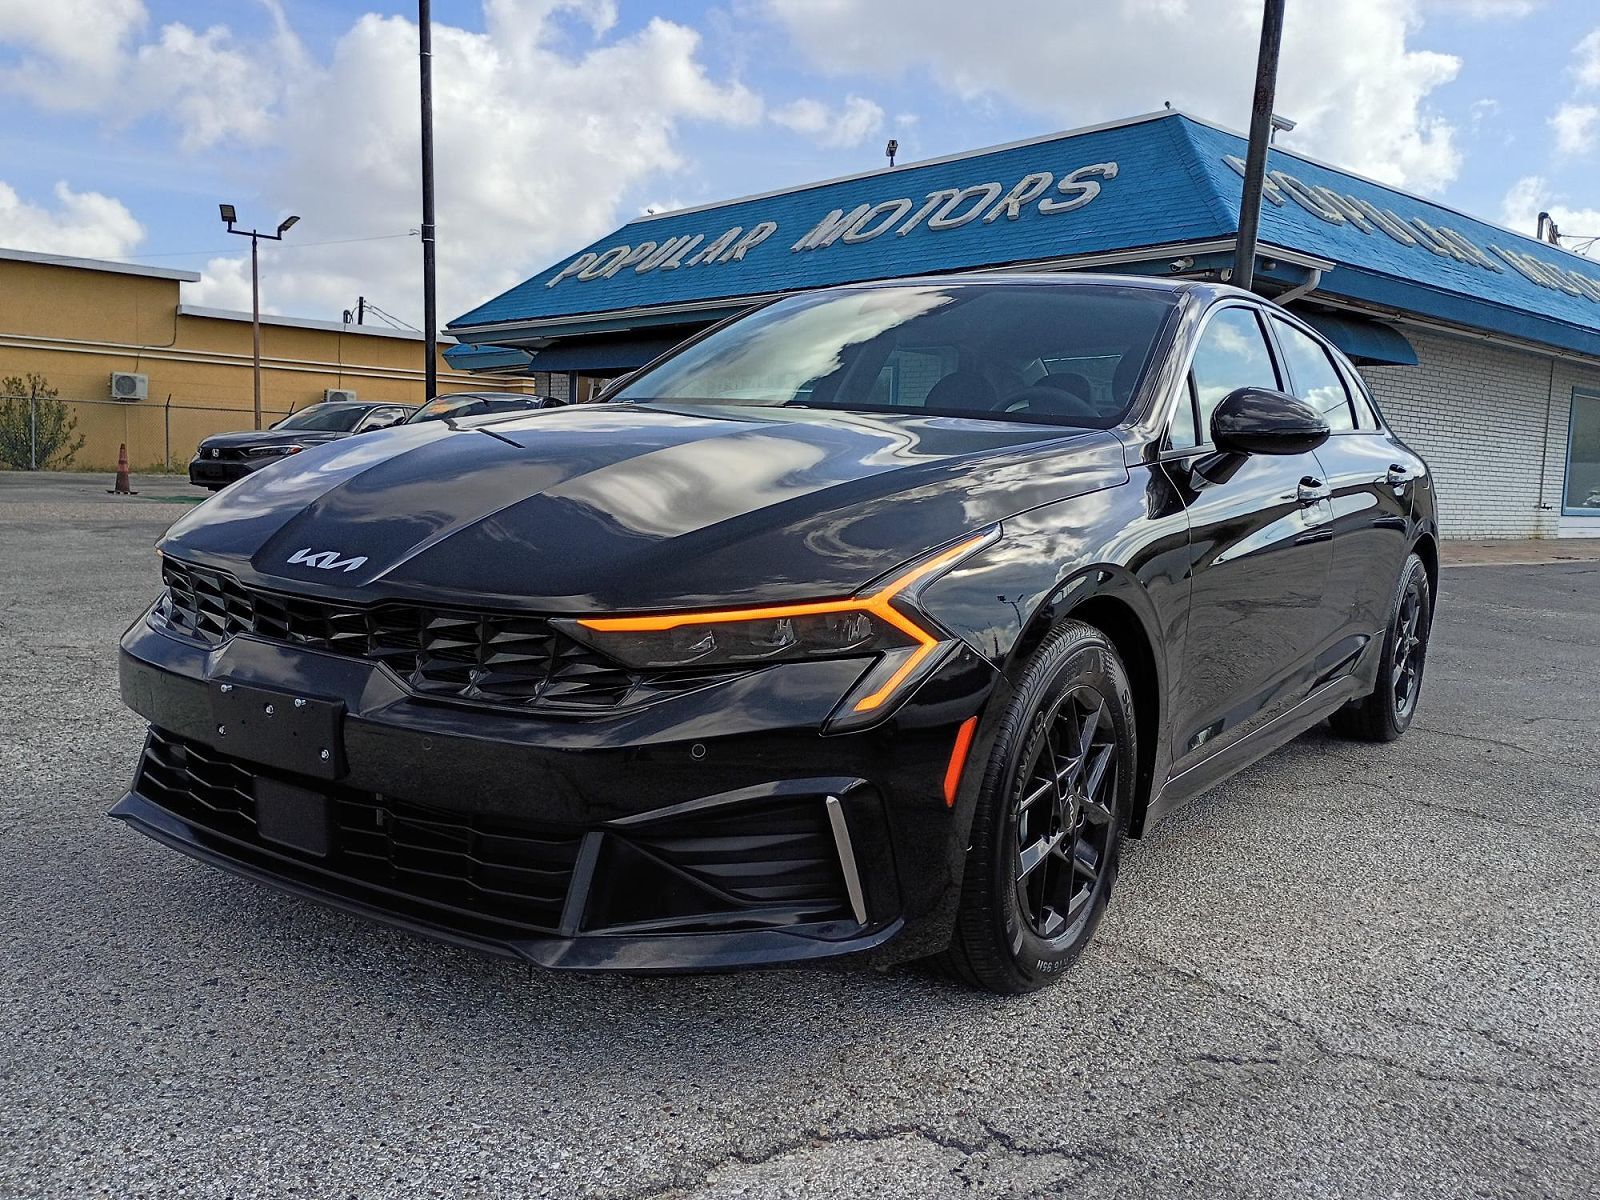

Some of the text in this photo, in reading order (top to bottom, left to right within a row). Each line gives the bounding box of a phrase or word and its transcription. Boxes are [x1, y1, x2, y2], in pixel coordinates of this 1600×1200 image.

[545, 161, 1120, 289] POPULAR MOTORS
[287, 547, 369, 573] KIA
